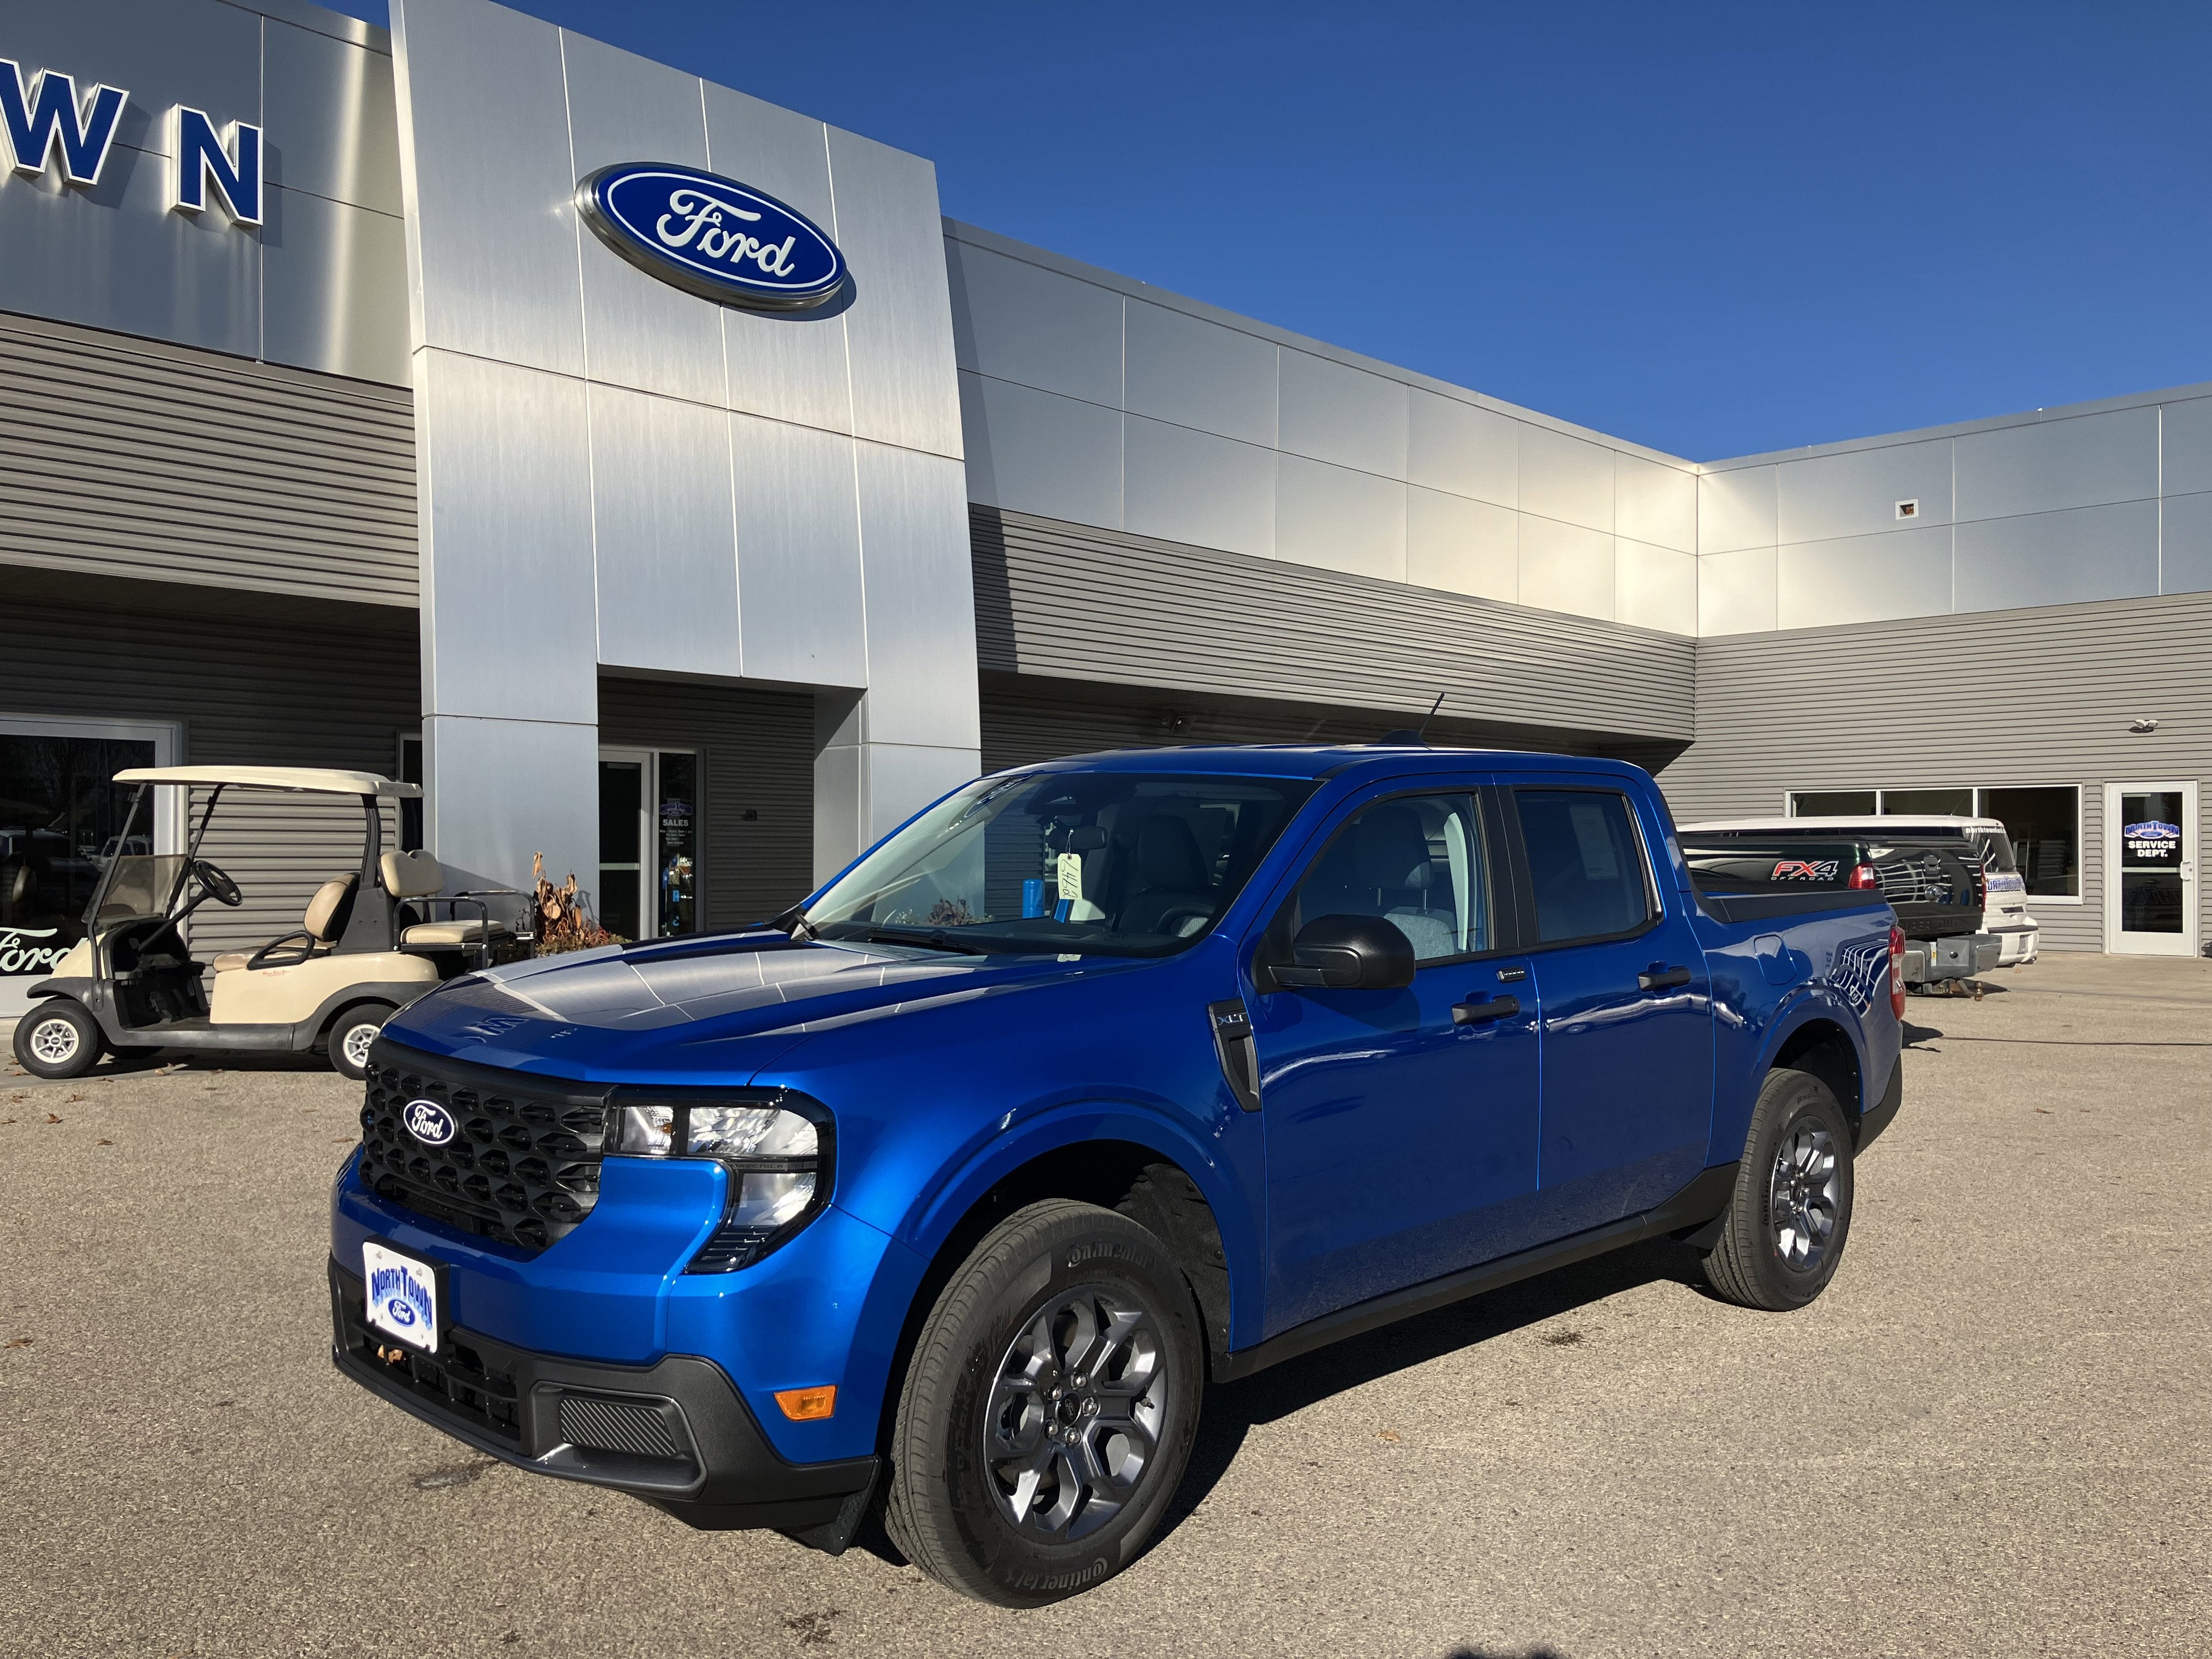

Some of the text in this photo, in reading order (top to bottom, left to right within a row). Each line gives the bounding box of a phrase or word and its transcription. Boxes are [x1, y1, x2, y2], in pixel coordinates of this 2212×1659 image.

[657, 189, 796, 277] Ford
[2129, 840, 2176, 849] SERVICE
[1772, 860, 1839, 877] FX4
[1217, 1014, 1244, 1026] XLT
[412, 1104, 444, 1139] Ford
[392, 1300, 411, 1323] Ford
